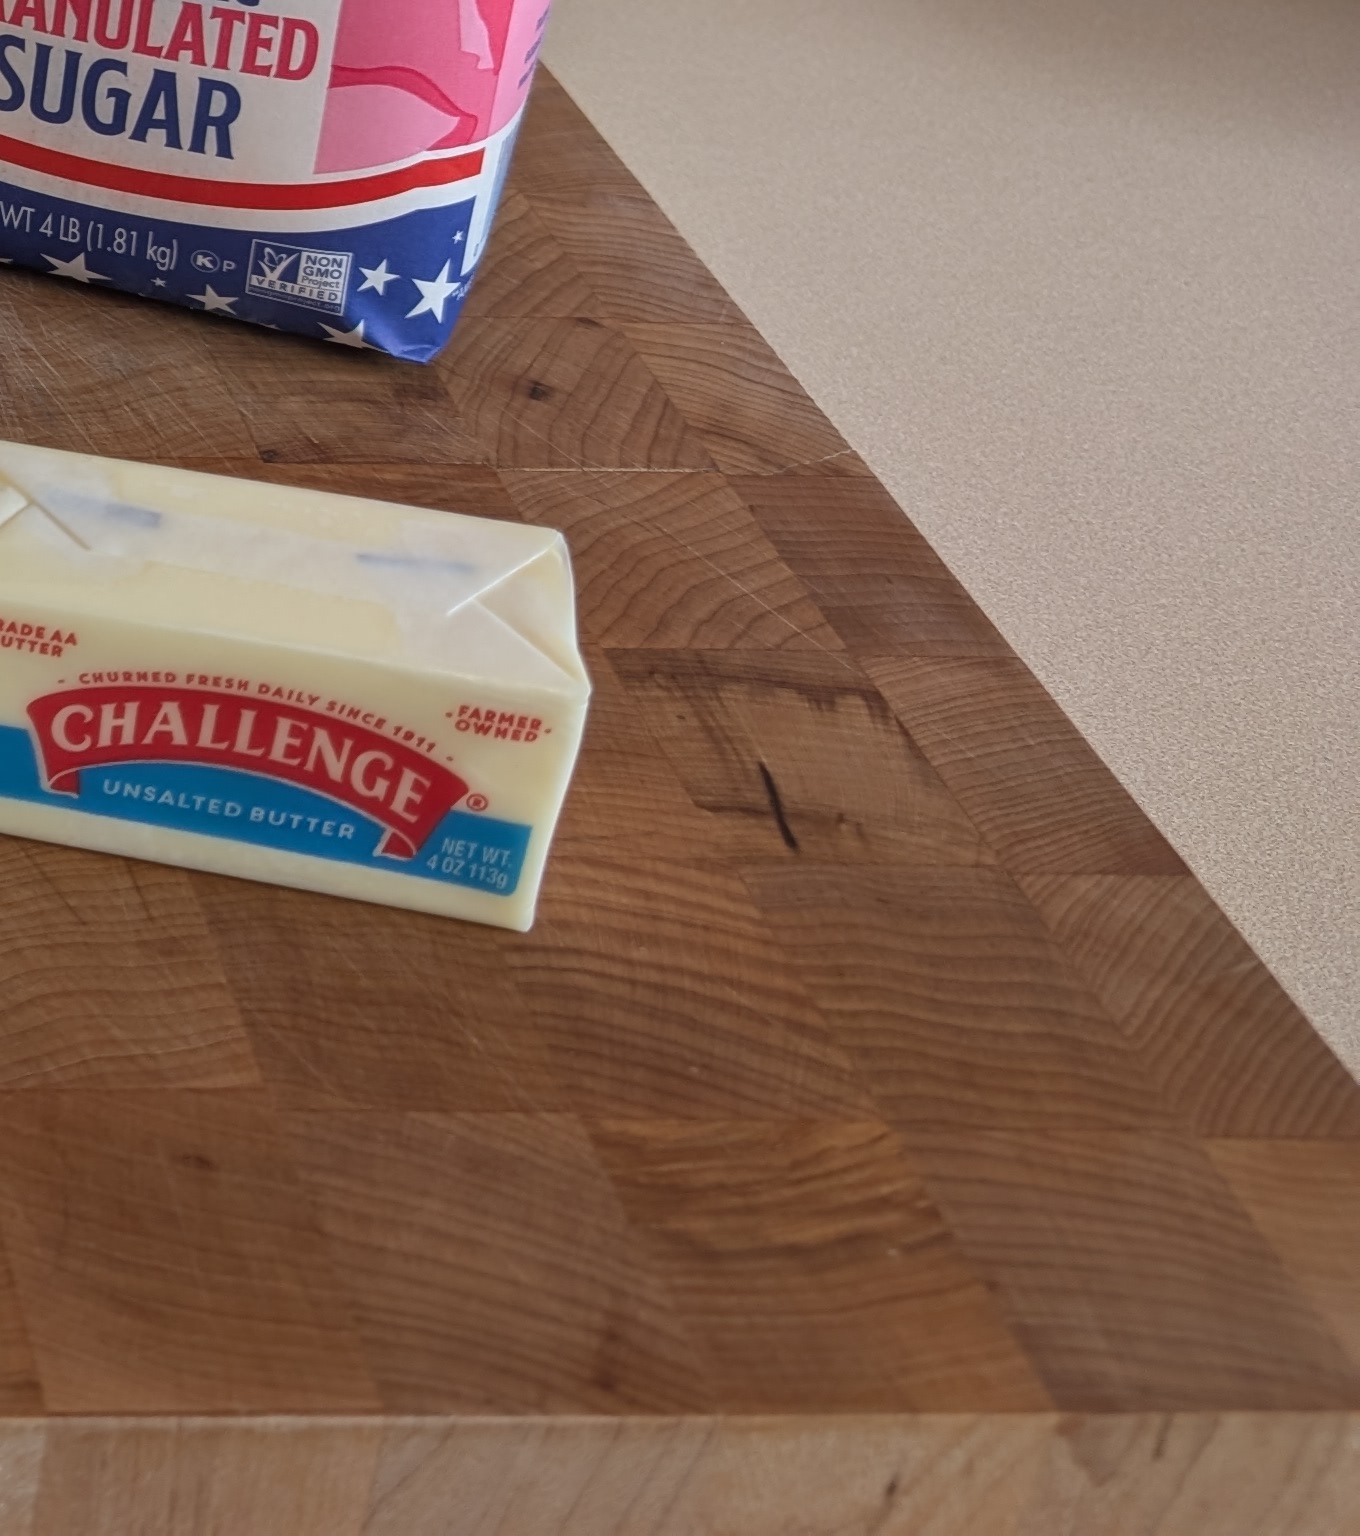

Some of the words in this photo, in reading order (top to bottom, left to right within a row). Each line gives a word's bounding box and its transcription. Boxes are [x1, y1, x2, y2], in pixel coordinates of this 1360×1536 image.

[0, 201, 35, 233] WT
[39, 213, 53, 237] 4
[59, 214, 80, 243] LB
[87, 221, 137, 256] (1.81
[146, 231, 178, 271] kg)
[223, 260, 236, 272] P
[303, 266, 342, 279] GMO
[305, 254, 343, 268] NON
[256, 277, 338, 302] VERIFIED
[301, 275, 340, 290] Project
[50, 629, 77, 646] AA
[79, 671, 177, 684] CHURNED
[186, 674, 250, 691] FRESH
[257, 683, 320, 706] DAILY
[326, 699, 387, 730] SINCE
[392, 725, 436, 753] 1911
[457, 704, 543, 731] FARMER
[454, 718, 538, 743] OWNED
[49, 700, 432, 824] CHALLENGE
[103, 778, 242, 817] UNSALTED
[249, 806, 355, 839] BUTTER
[441, 837, 478, 858] NET
[426, 854, 436, 870] 4
[441, 858, 466, 876] OZ
[468, 864, 508, 889] 113g
